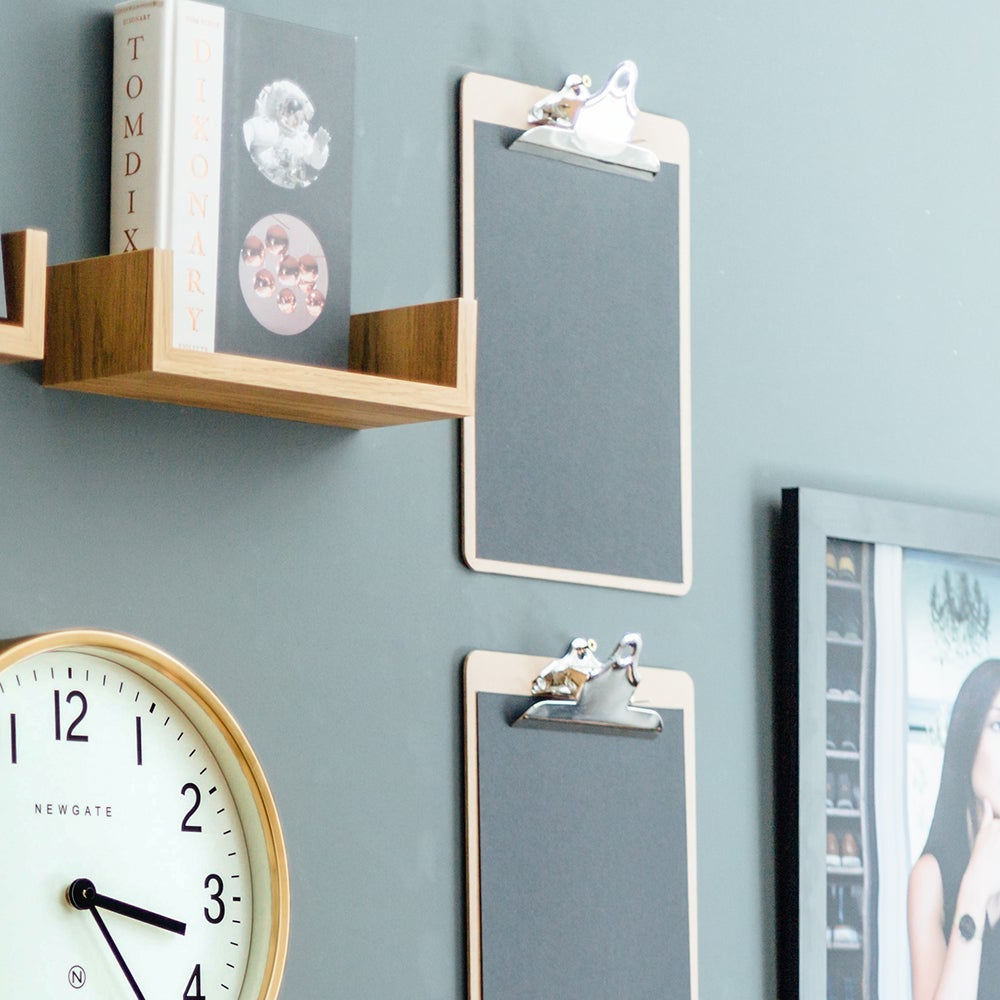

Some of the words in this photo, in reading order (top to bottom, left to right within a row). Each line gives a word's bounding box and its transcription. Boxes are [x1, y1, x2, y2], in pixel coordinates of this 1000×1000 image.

[186, 37, 213, 332] DIXONARY
[54, 689, 89, 743] 12
[135, 716, 143, 766] 1
[35, 803, 113, 817] NEWGATE
[180, 782, 202, 833] 2
[203, 873, 226, 925] 3
